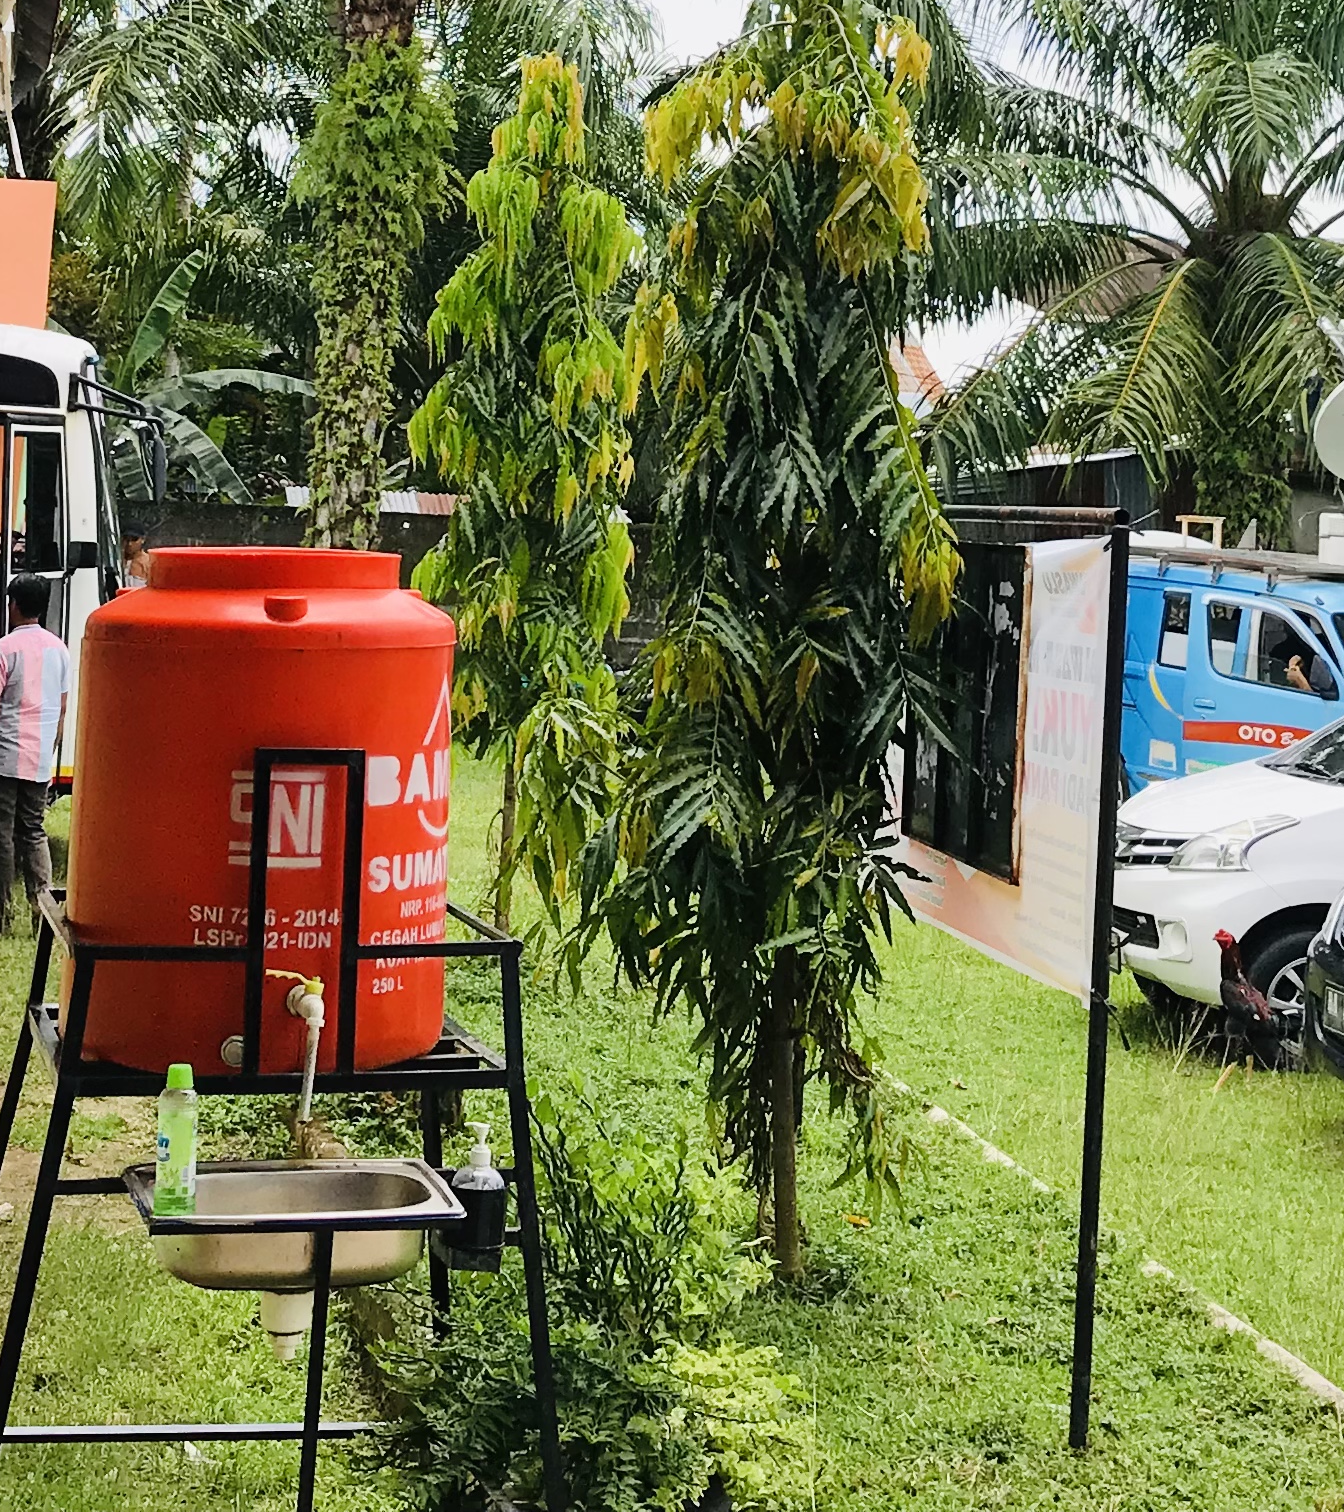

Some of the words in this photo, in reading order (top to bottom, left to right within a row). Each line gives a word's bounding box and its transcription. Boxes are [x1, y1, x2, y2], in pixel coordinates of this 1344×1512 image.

[1238, 724, 1276, 744] OTO
[189, 905, 224, 923] SNI
[231, 907, 276, 927] 726
[293, 908, 340, 928] 2014
[370, 926, 418, 945] CEGAH
[372, 977, 395, 994] 250
[397, 975, 404, 991] L
